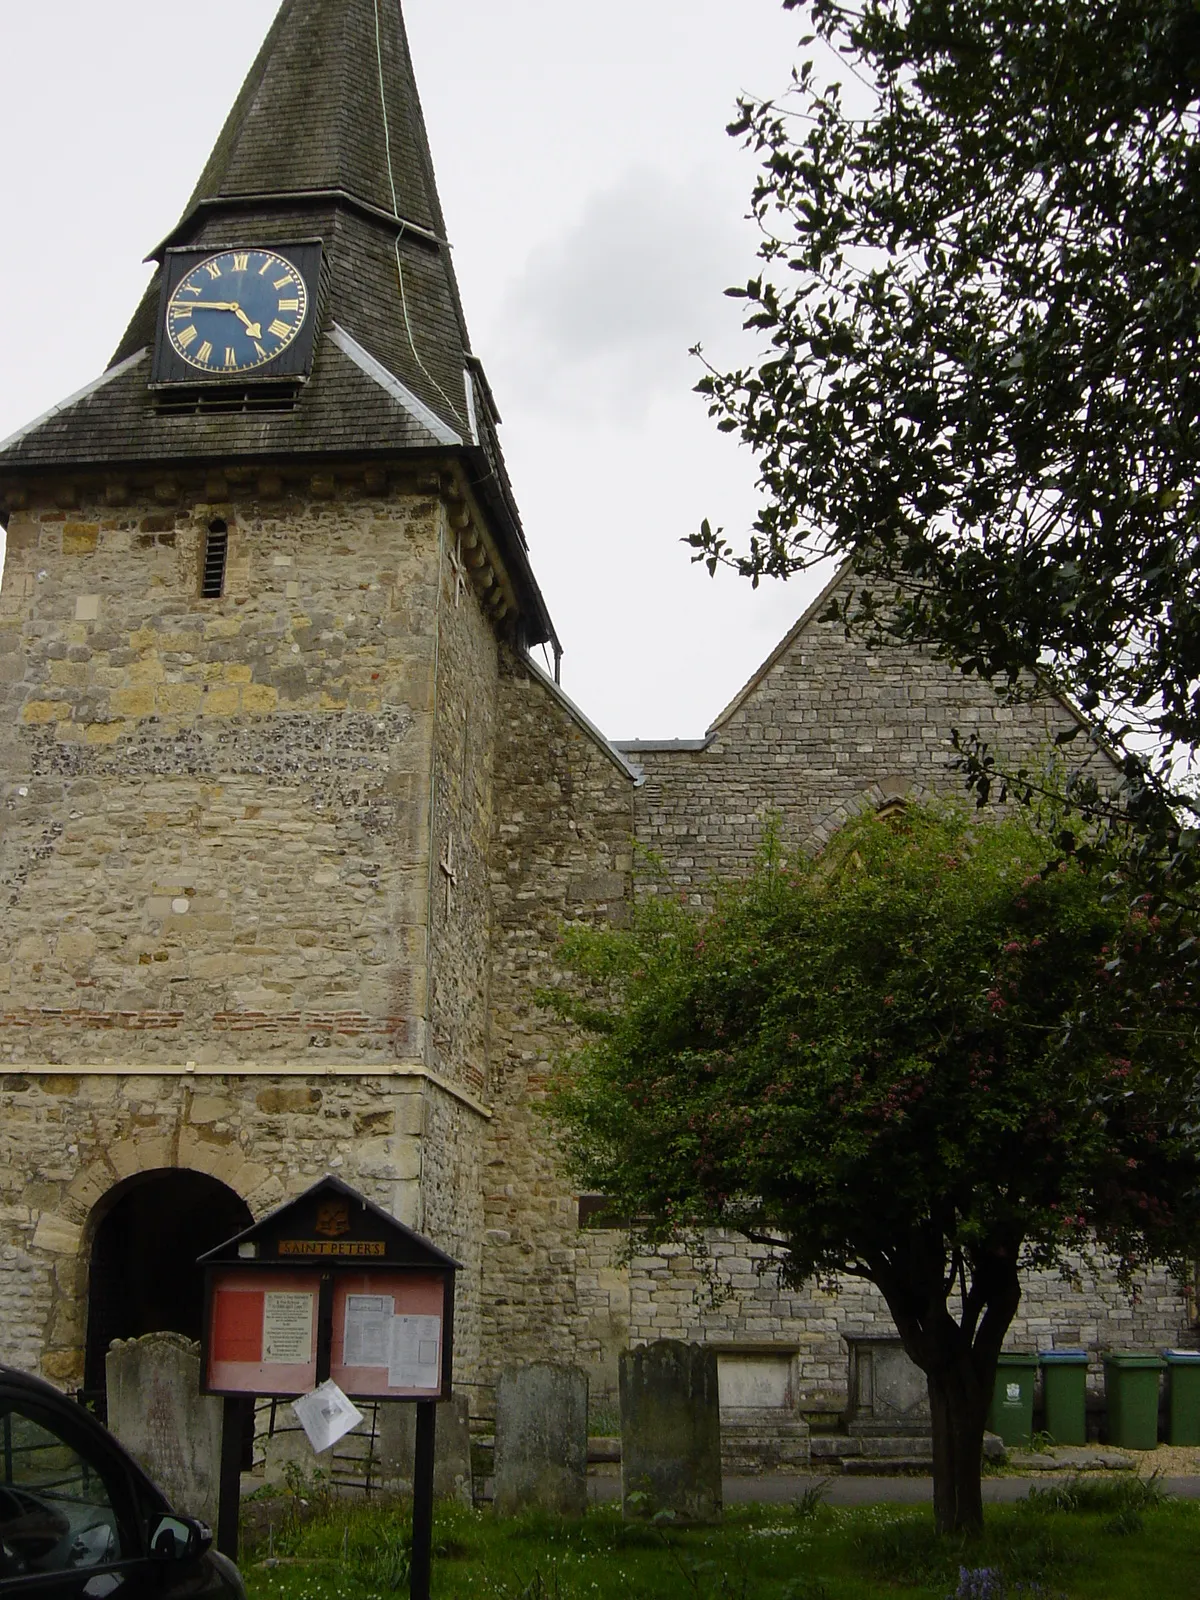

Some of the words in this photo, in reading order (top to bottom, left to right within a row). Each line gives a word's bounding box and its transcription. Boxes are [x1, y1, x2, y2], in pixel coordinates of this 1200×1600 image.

[204, 261, 222, 280] XI
[231, 253, 250, 271] XII
[184, 283, 202, 296] X
[272, 274, 294, 290] II
[278, 299, 299, 311] III
[196, 341, 213, 363] VII
[224, 347, 237, 366] VI
[253, 340, 267, 358] V
[284, 1242, 328, 1254] SAINT
[330, 1243, 381, 1255] PETER'S
